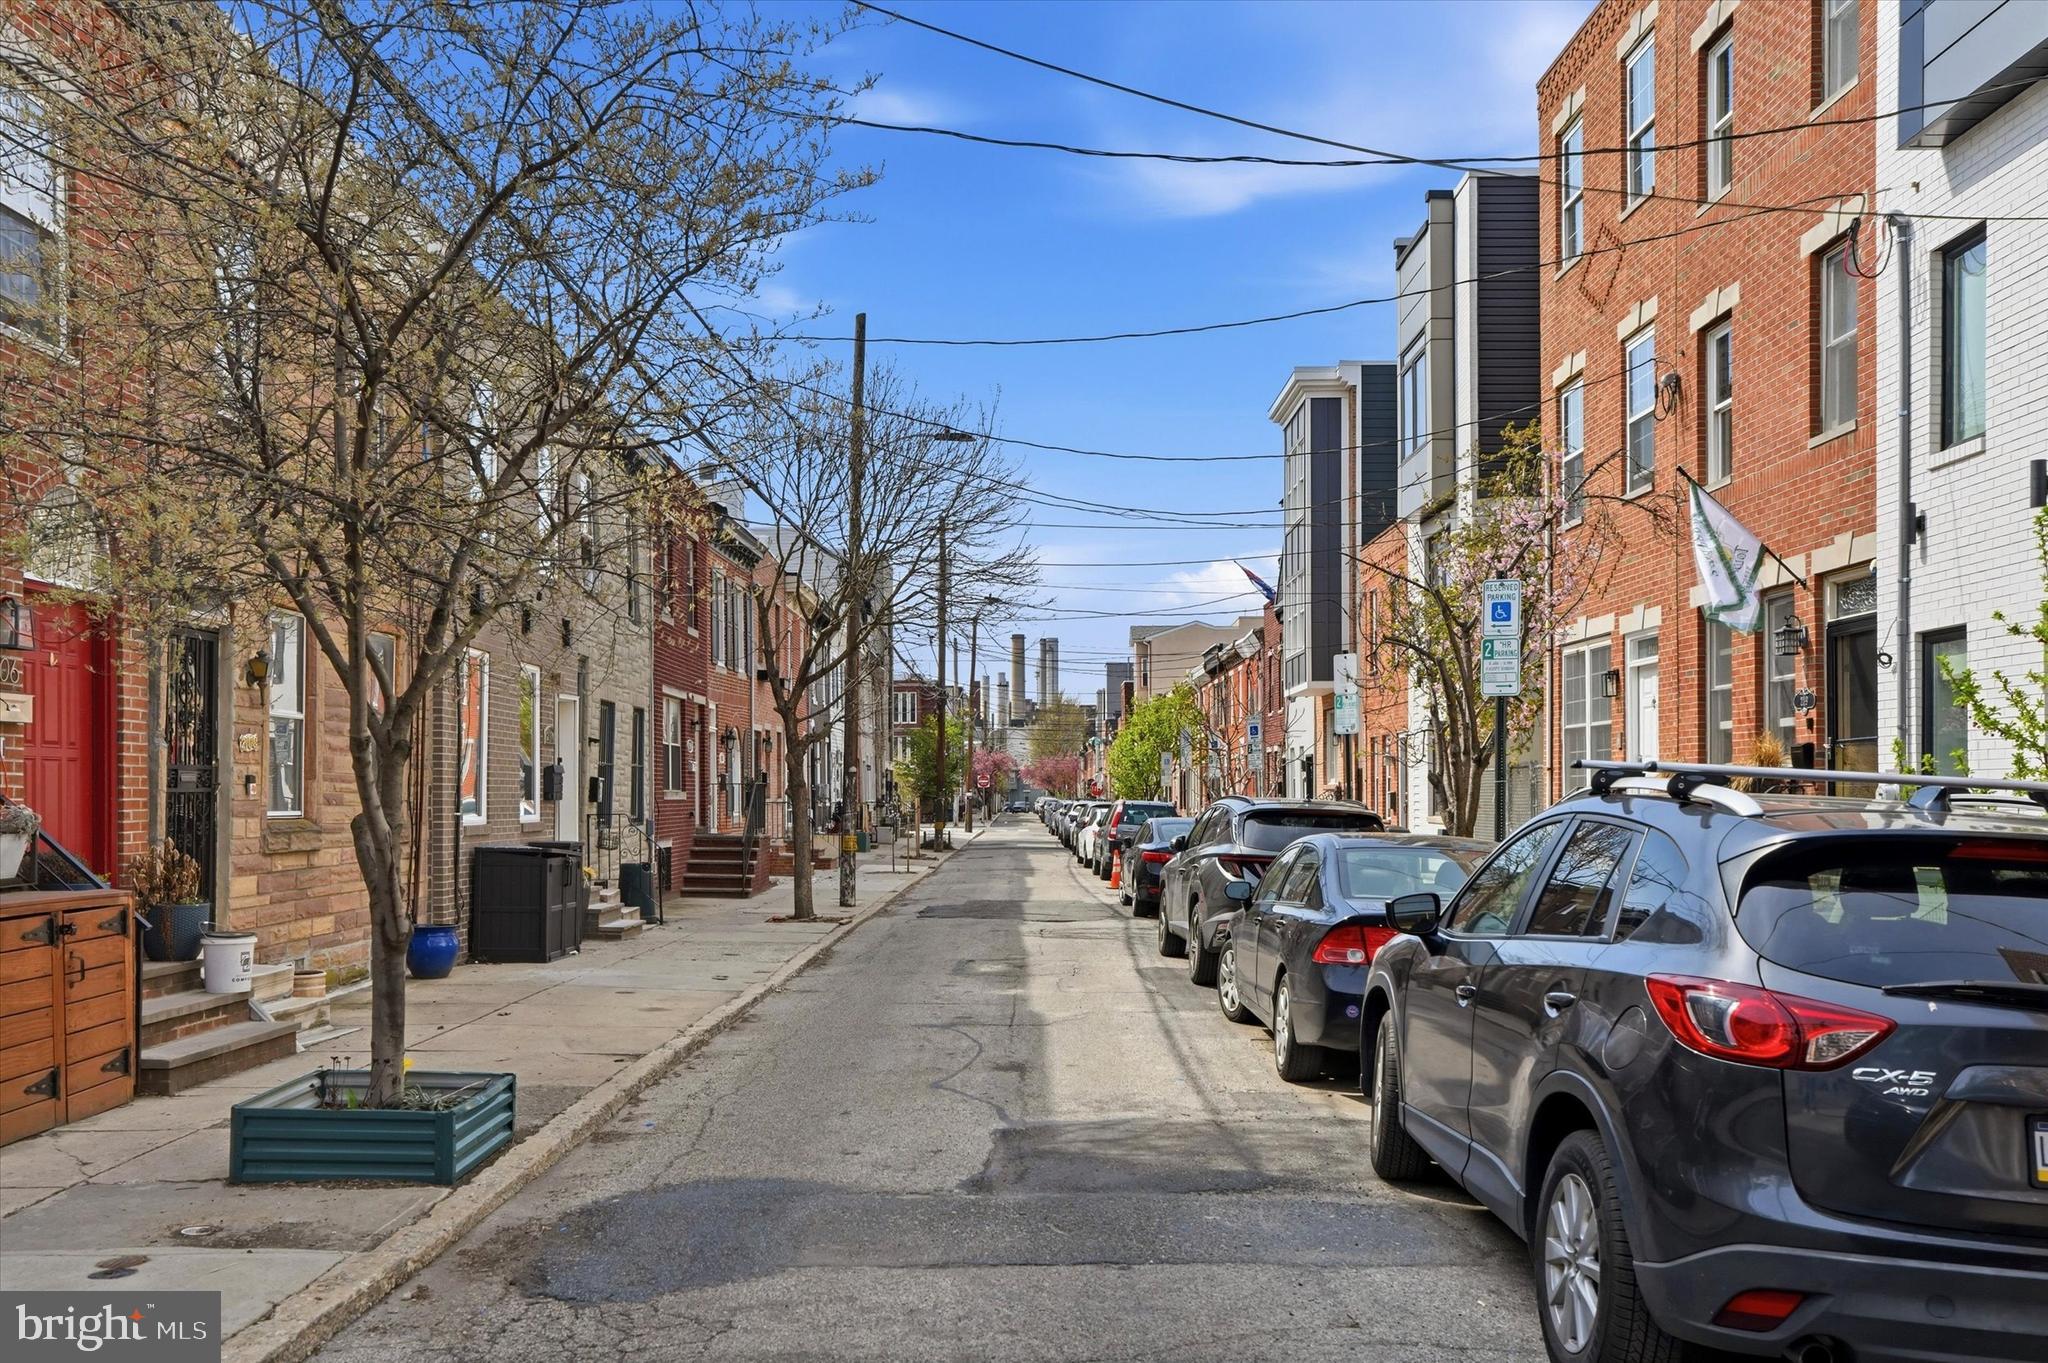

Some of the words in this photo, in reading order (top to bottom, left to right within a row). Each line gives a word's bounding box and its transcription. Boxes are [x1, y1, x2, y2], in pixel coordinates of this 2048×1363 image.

[1486, 583, 1518, 591] RESERVED
[1485, 642, 1492, 656] 2
[1494, 649, 1518, 657] PARKING
[1851, 1067, 1937, 1086] CX-5
[1882, 1086, 1930, 1096] AWD
